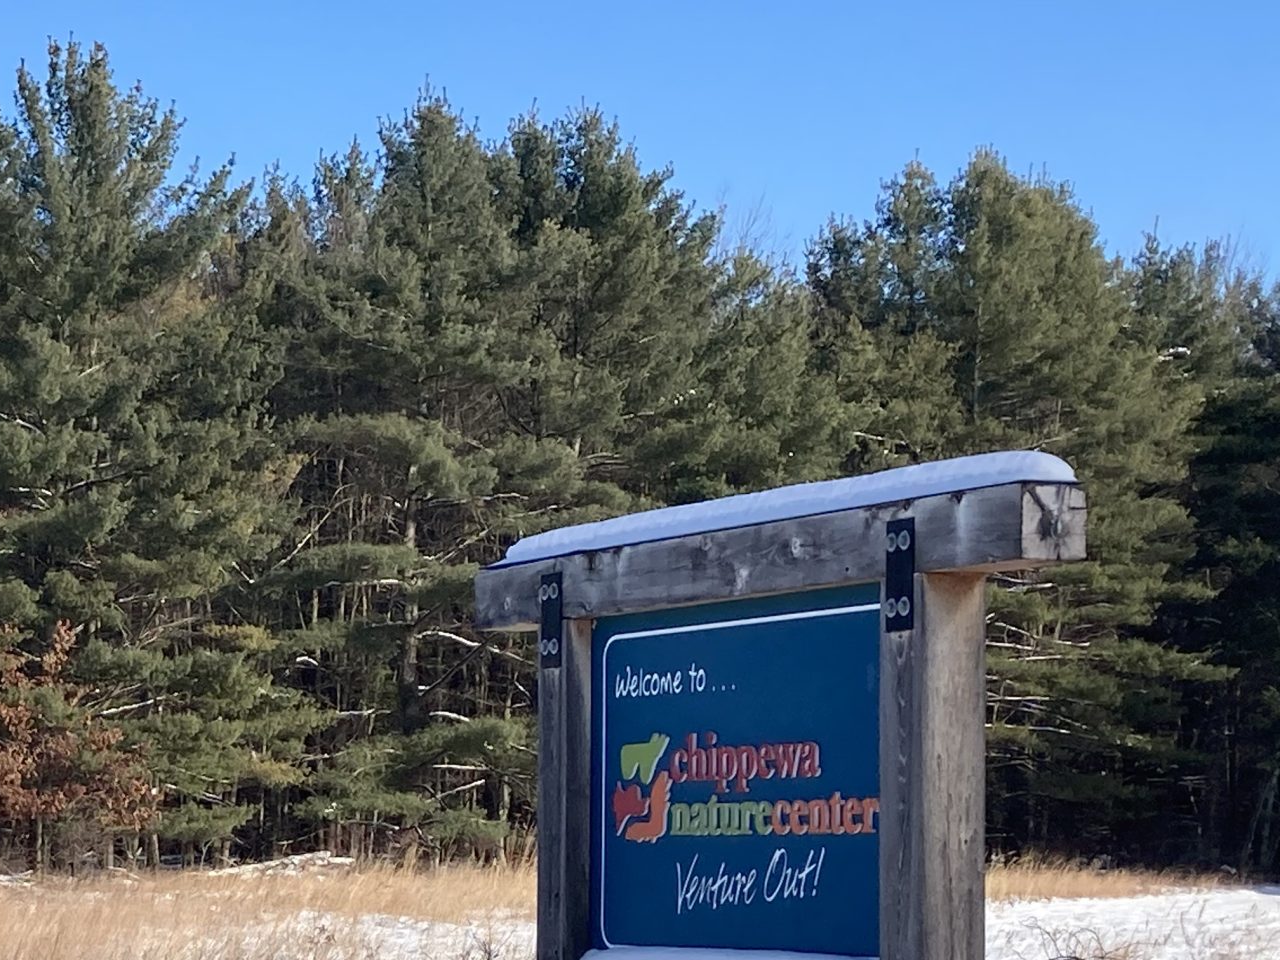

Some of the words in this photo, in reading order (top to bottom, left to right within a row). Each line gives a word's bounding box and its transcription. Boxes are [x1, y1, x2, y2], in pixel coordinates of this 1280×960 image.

[615, 665, 683, 698] Welcome
[670, 731, 821, 793] chippewa
[675, 853, 757, 914] Venture
[764, 847, 825, 902] Out!
